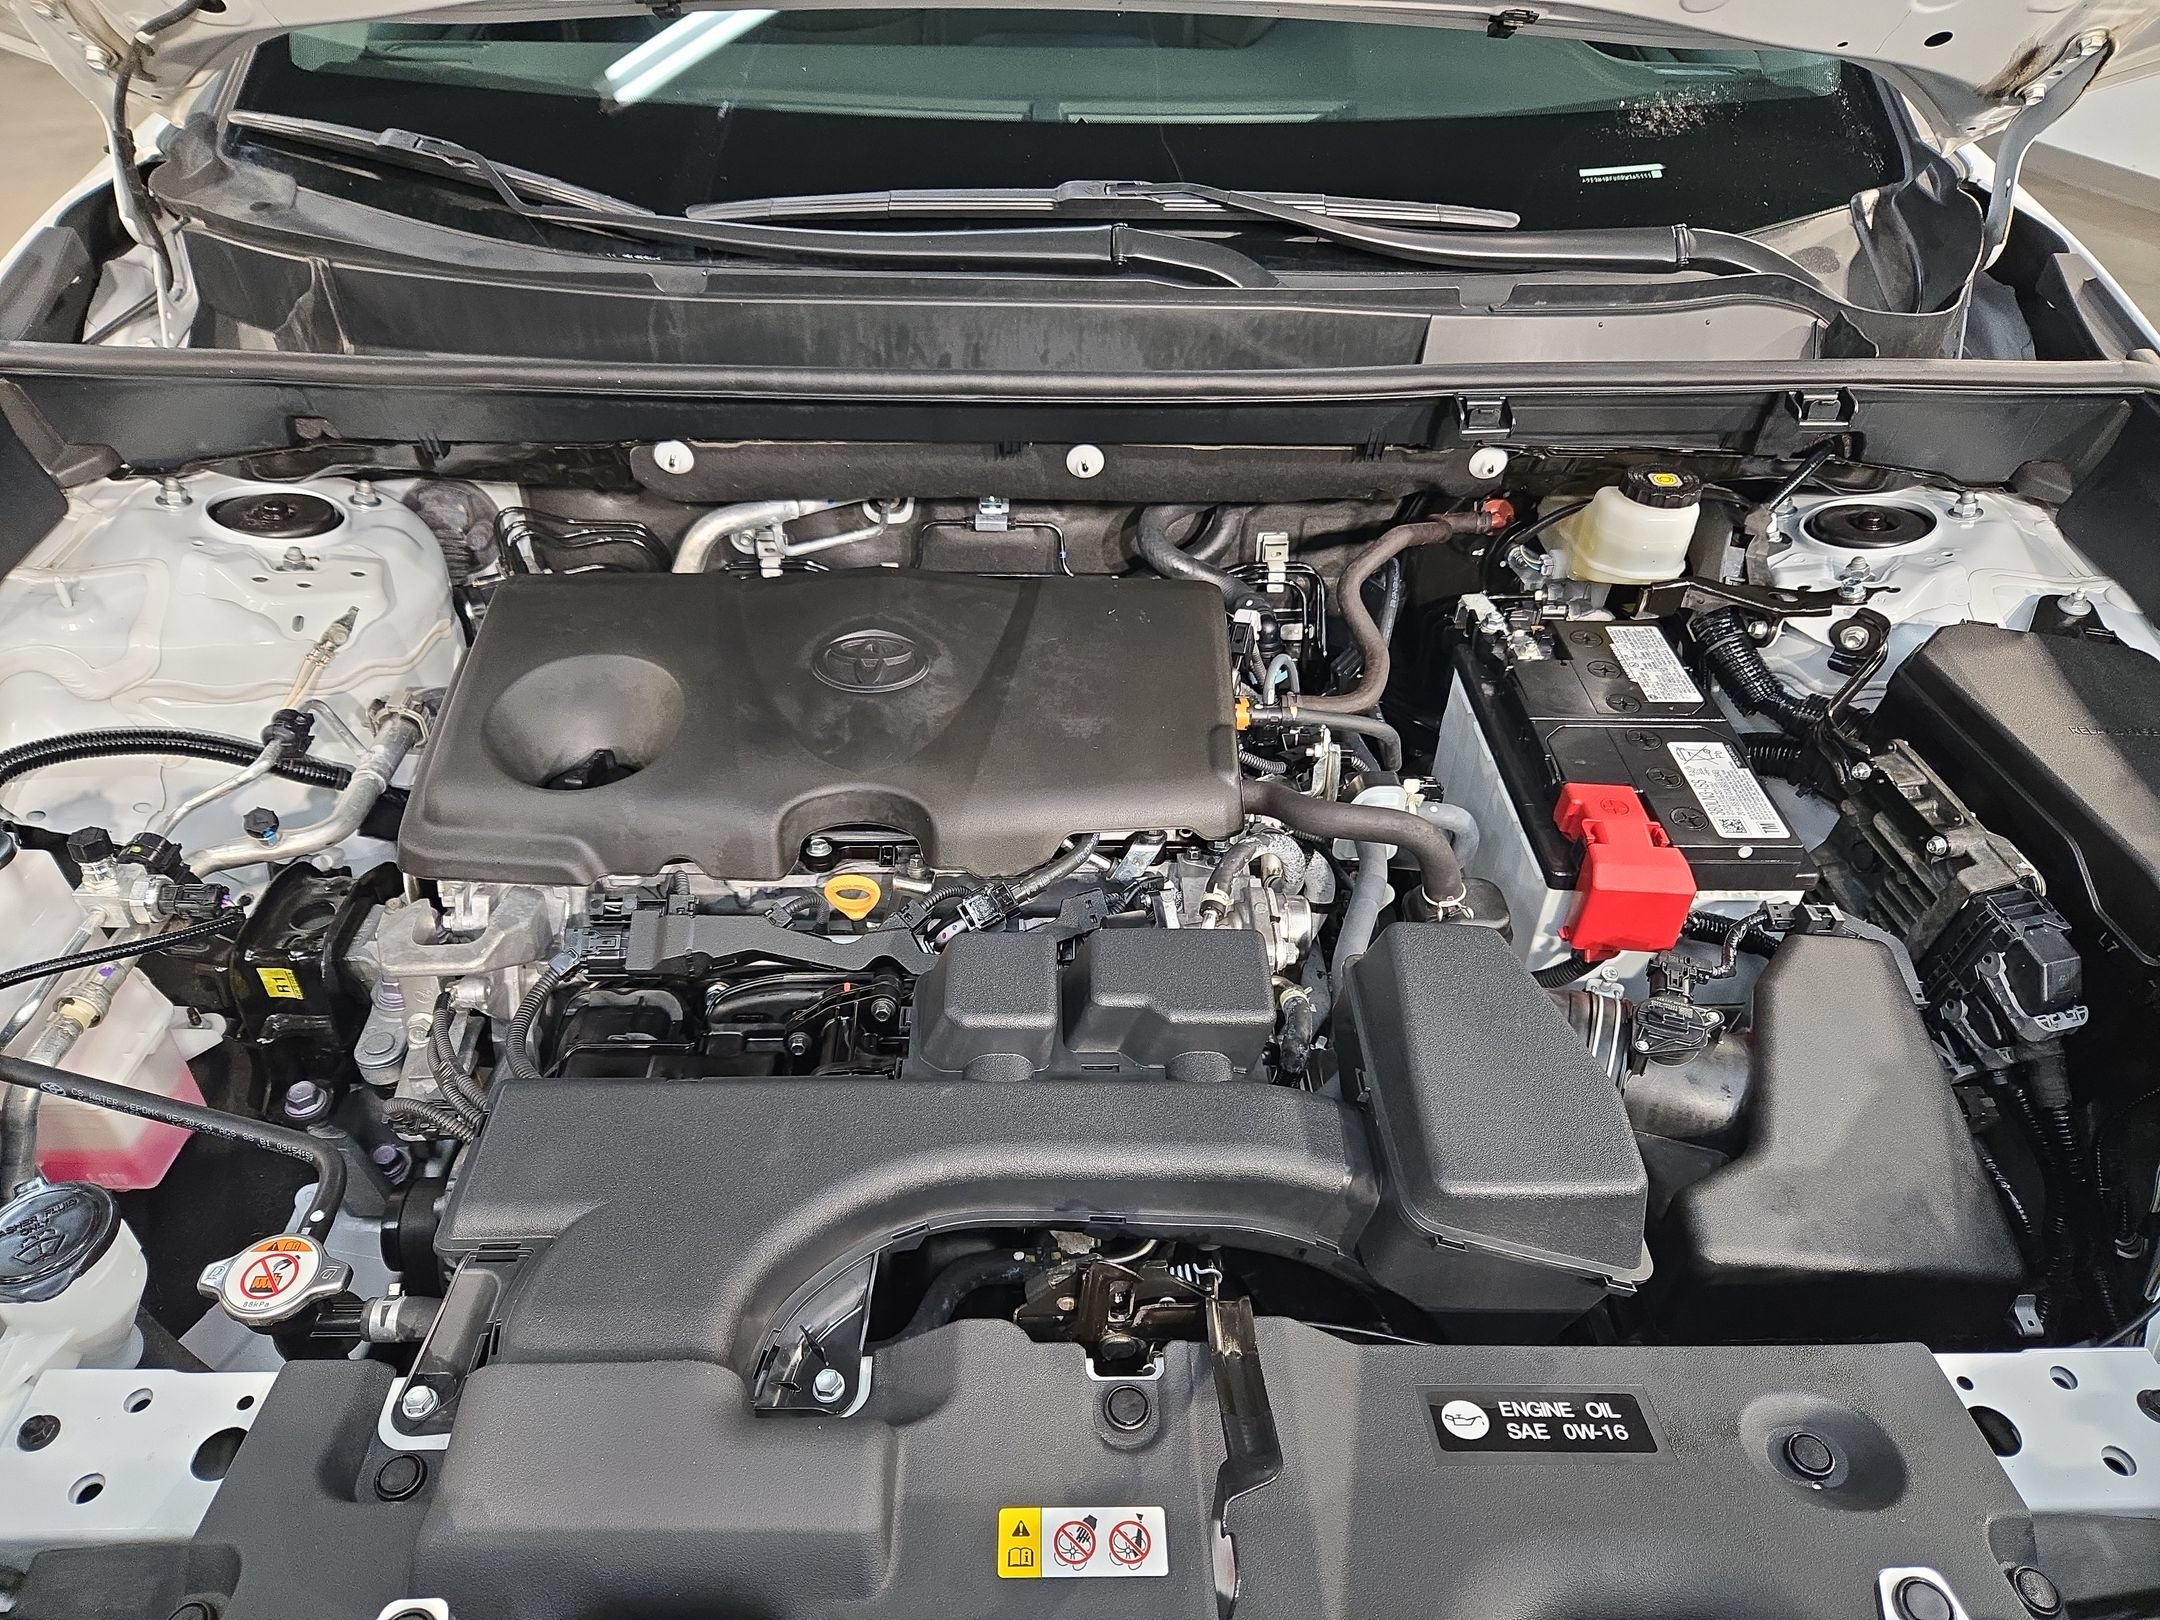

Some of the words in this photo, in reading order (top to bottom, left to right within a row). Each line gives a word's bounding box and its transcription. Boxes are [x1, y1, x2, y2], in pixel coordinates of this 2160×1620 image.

[89, 1091, 119, 1106] WATER
[0, 1215, 38, 1237] ASHER
[44, 1198, 78, 1217] FLUID
[20, 1217, 49, 1236] ONLY
[1498, 1401, 1575, 1418] ENGINE
[1585, 1401, 1622, 1419] OIL
[1506, 1423, 1551, 1440] SAE
[1562, 1423, 1629, 1441] 0W-16
